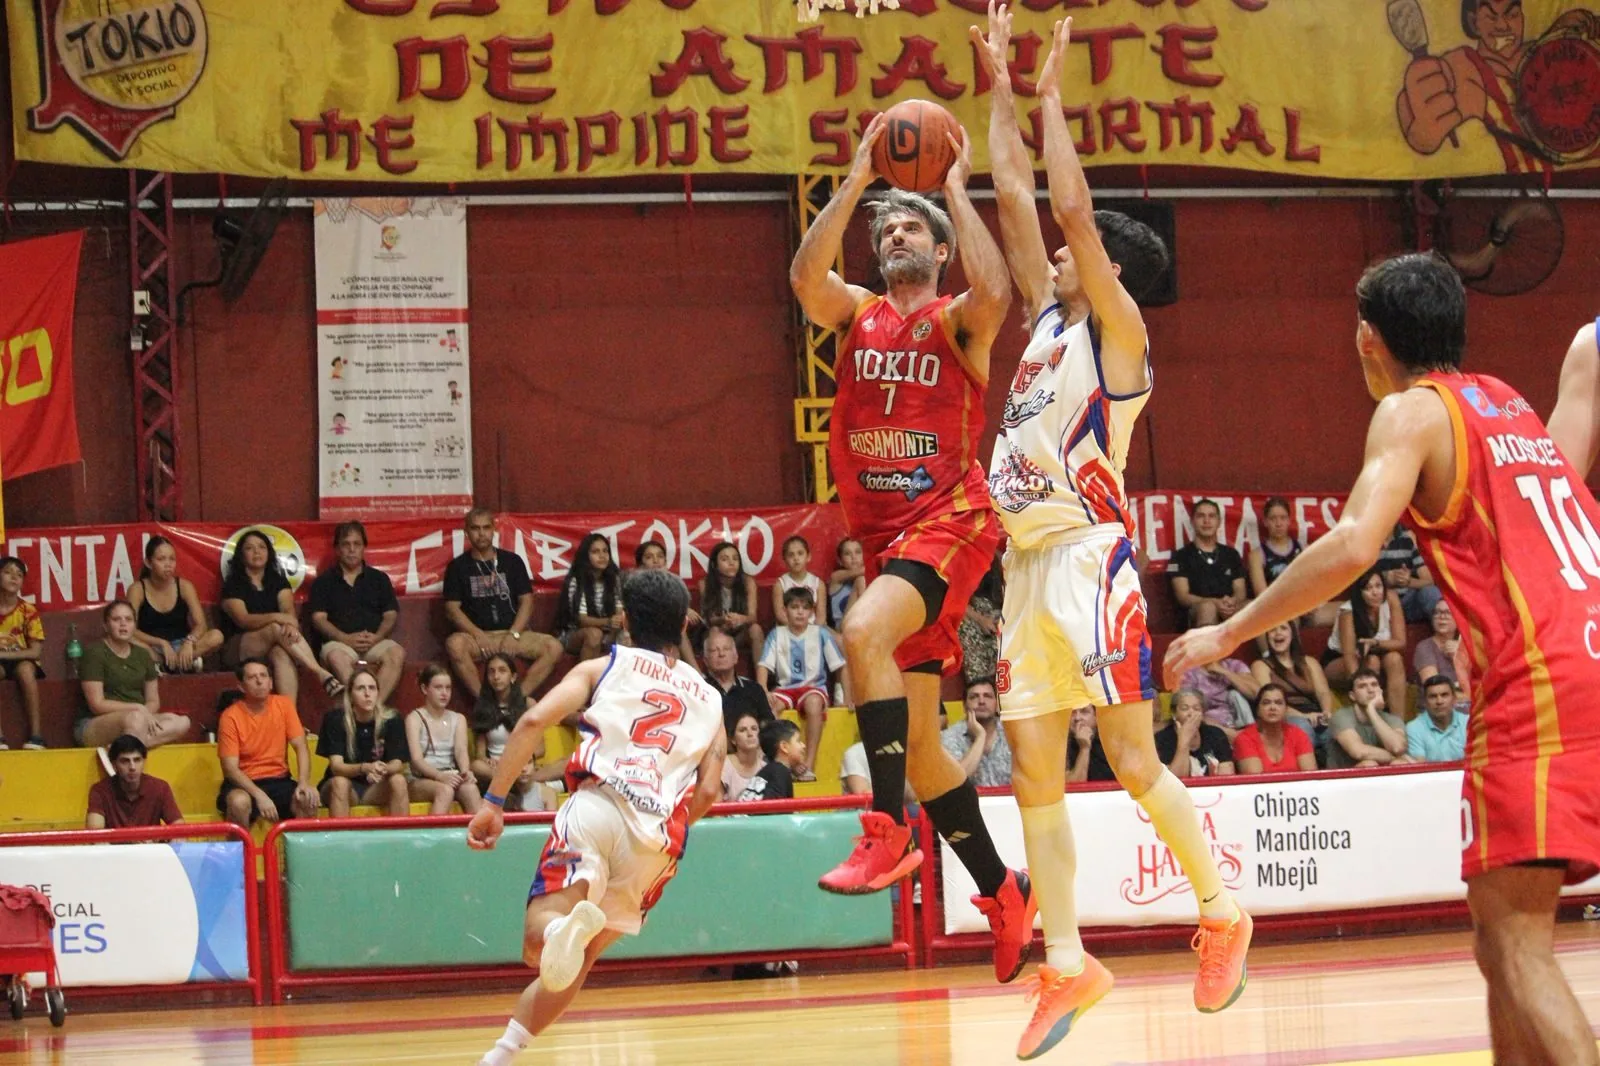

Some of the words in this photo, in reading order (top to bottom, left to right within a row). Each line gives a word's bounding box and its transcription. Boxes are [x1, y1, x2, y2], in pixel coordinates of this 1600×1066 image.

[66, 3, 196, 69] TOKIO
[117, 64, 177, 83] DEPORTIVO
[394, 33, 556, 103] DE
[650, 23, 1224, 97] AMARTE
[127, 87, 134, 97] Y
[137, 79, 177, 96] SOCIAL
[290, 108, 418, 174] ME
[475, 104, 752, 172] IMPIDE
[1018, 95, 1320, 162] NORMAL
[0, 327, 53, 410] O
[854, 348, 941, 387] TOKIO
[879, 383, 896, 416] 7
[850, 431, 937, 460] ROSAMONTE
[1129, 494, 1339, 561] IENTAES
[1514, 473, 1600, 591] 10
[791, 658, 803, 674] 9
[1082, 648, 1126, 674] Hercules
[629, 688, 687, 755] 2
[1254, 793, 1320, 822] Chipas
[1256, 827, 1351, 853] Mandioca
[1257, 857, 1318, 892] Mbejû
[53, 902, 101, 918] CIAL
